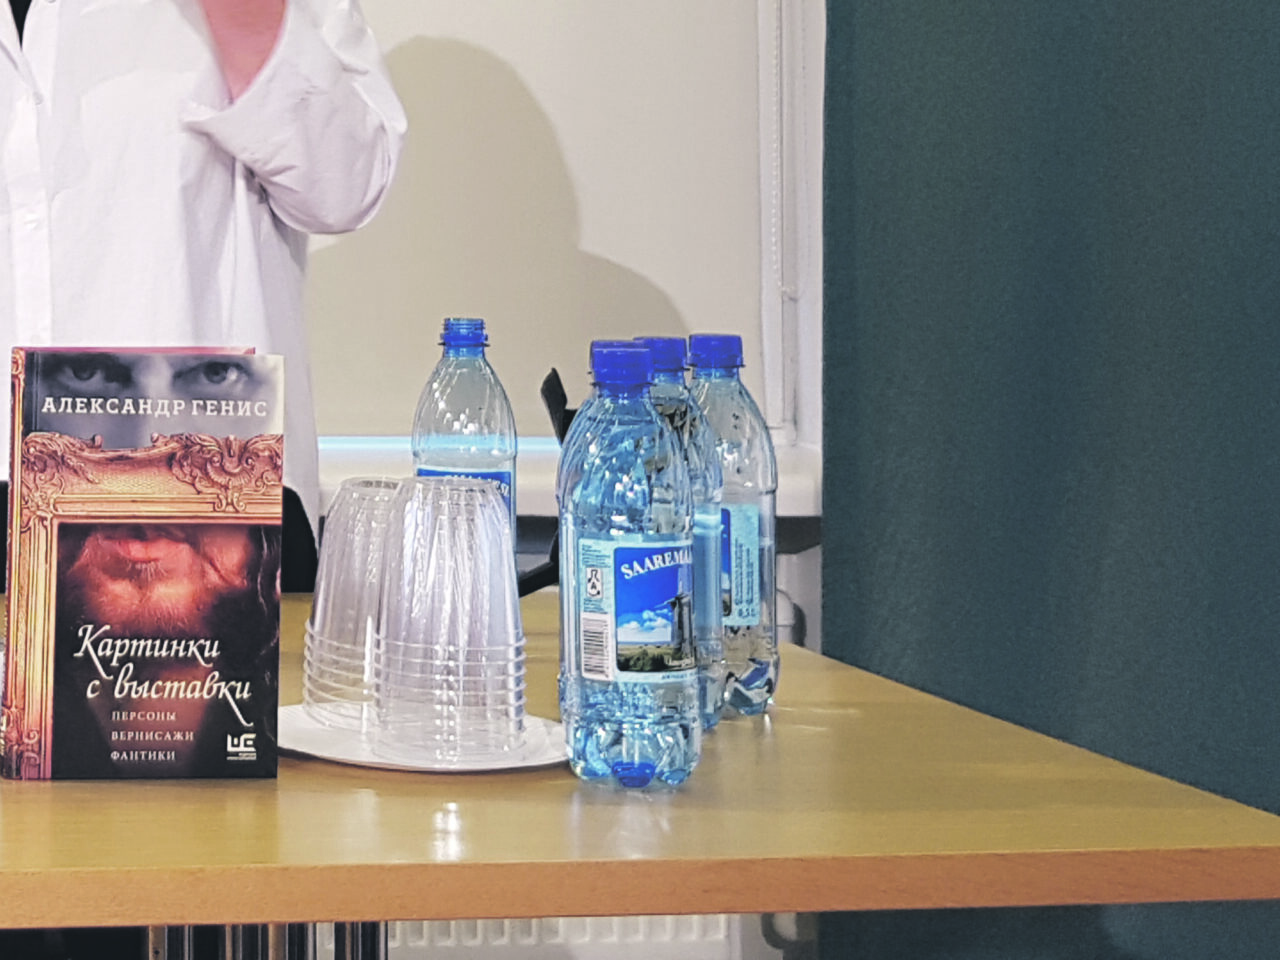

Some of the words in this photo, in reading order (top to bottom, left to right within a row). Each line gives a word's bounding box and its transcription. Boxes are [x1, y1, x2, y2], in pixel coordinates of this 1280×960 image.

[41, 396, 185, 418] АЛЕКСАНДР
[191, 399, 267, 417] ГЕНИС
[73, 624, 221, 680] Картинки
[86, 678, 100, 699] с
[114, 662, 252, 727] выставки
[111, 710, 177, 721] ПЕРСОНЫ
[111, 730, 195, 742] ВЕРНИСАЖИ
[110, 750, 176, 761] ФАНТИКИ
